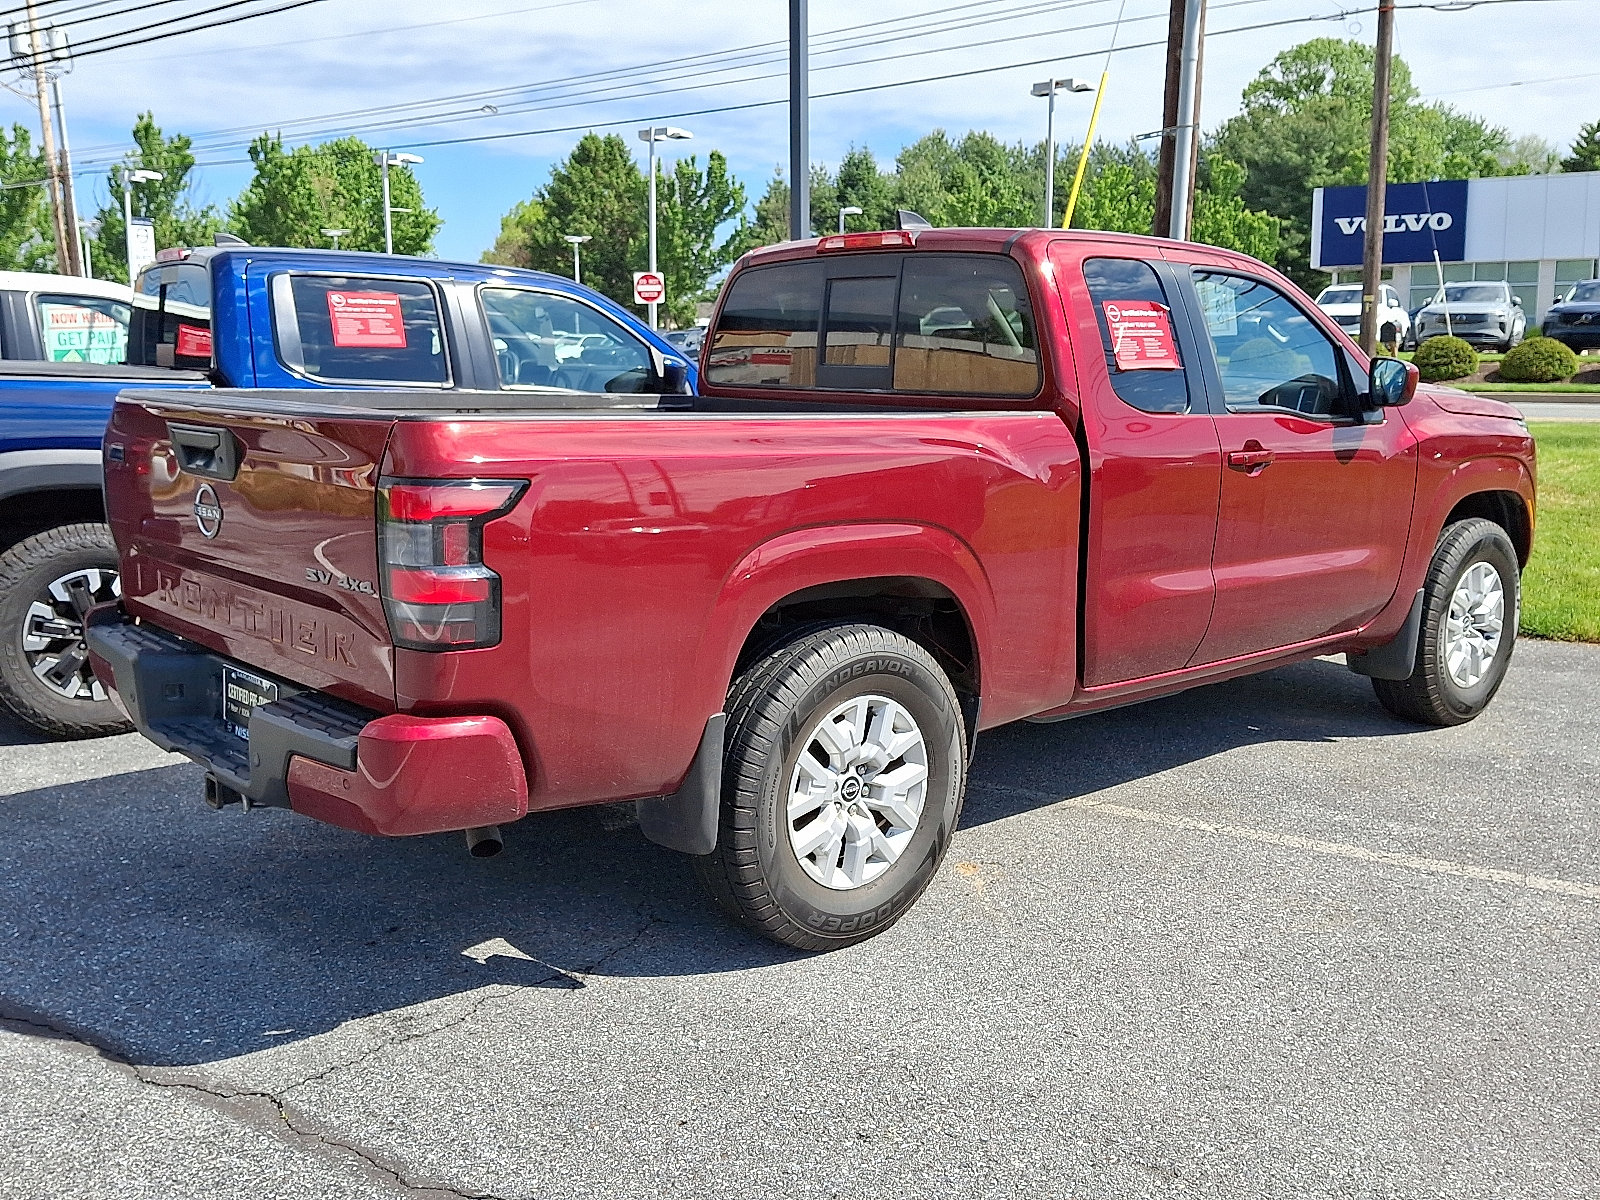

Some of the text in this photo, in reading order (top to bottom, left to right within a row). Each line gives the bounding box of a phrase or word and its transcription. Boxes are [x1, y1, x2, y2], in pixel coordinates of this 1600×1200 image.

[51, 311, 113, 324] NOW HIRIN
[57, 330, 118, 346] GET PAID
[194, 504, 220, 519] ISSAN
[305, 567, 332, 586] SV
[813, 659, 913, 703] ENDEAVOR
[235, 725, 249, 738] NISS
[807, 890, 906, 932] COOPER
